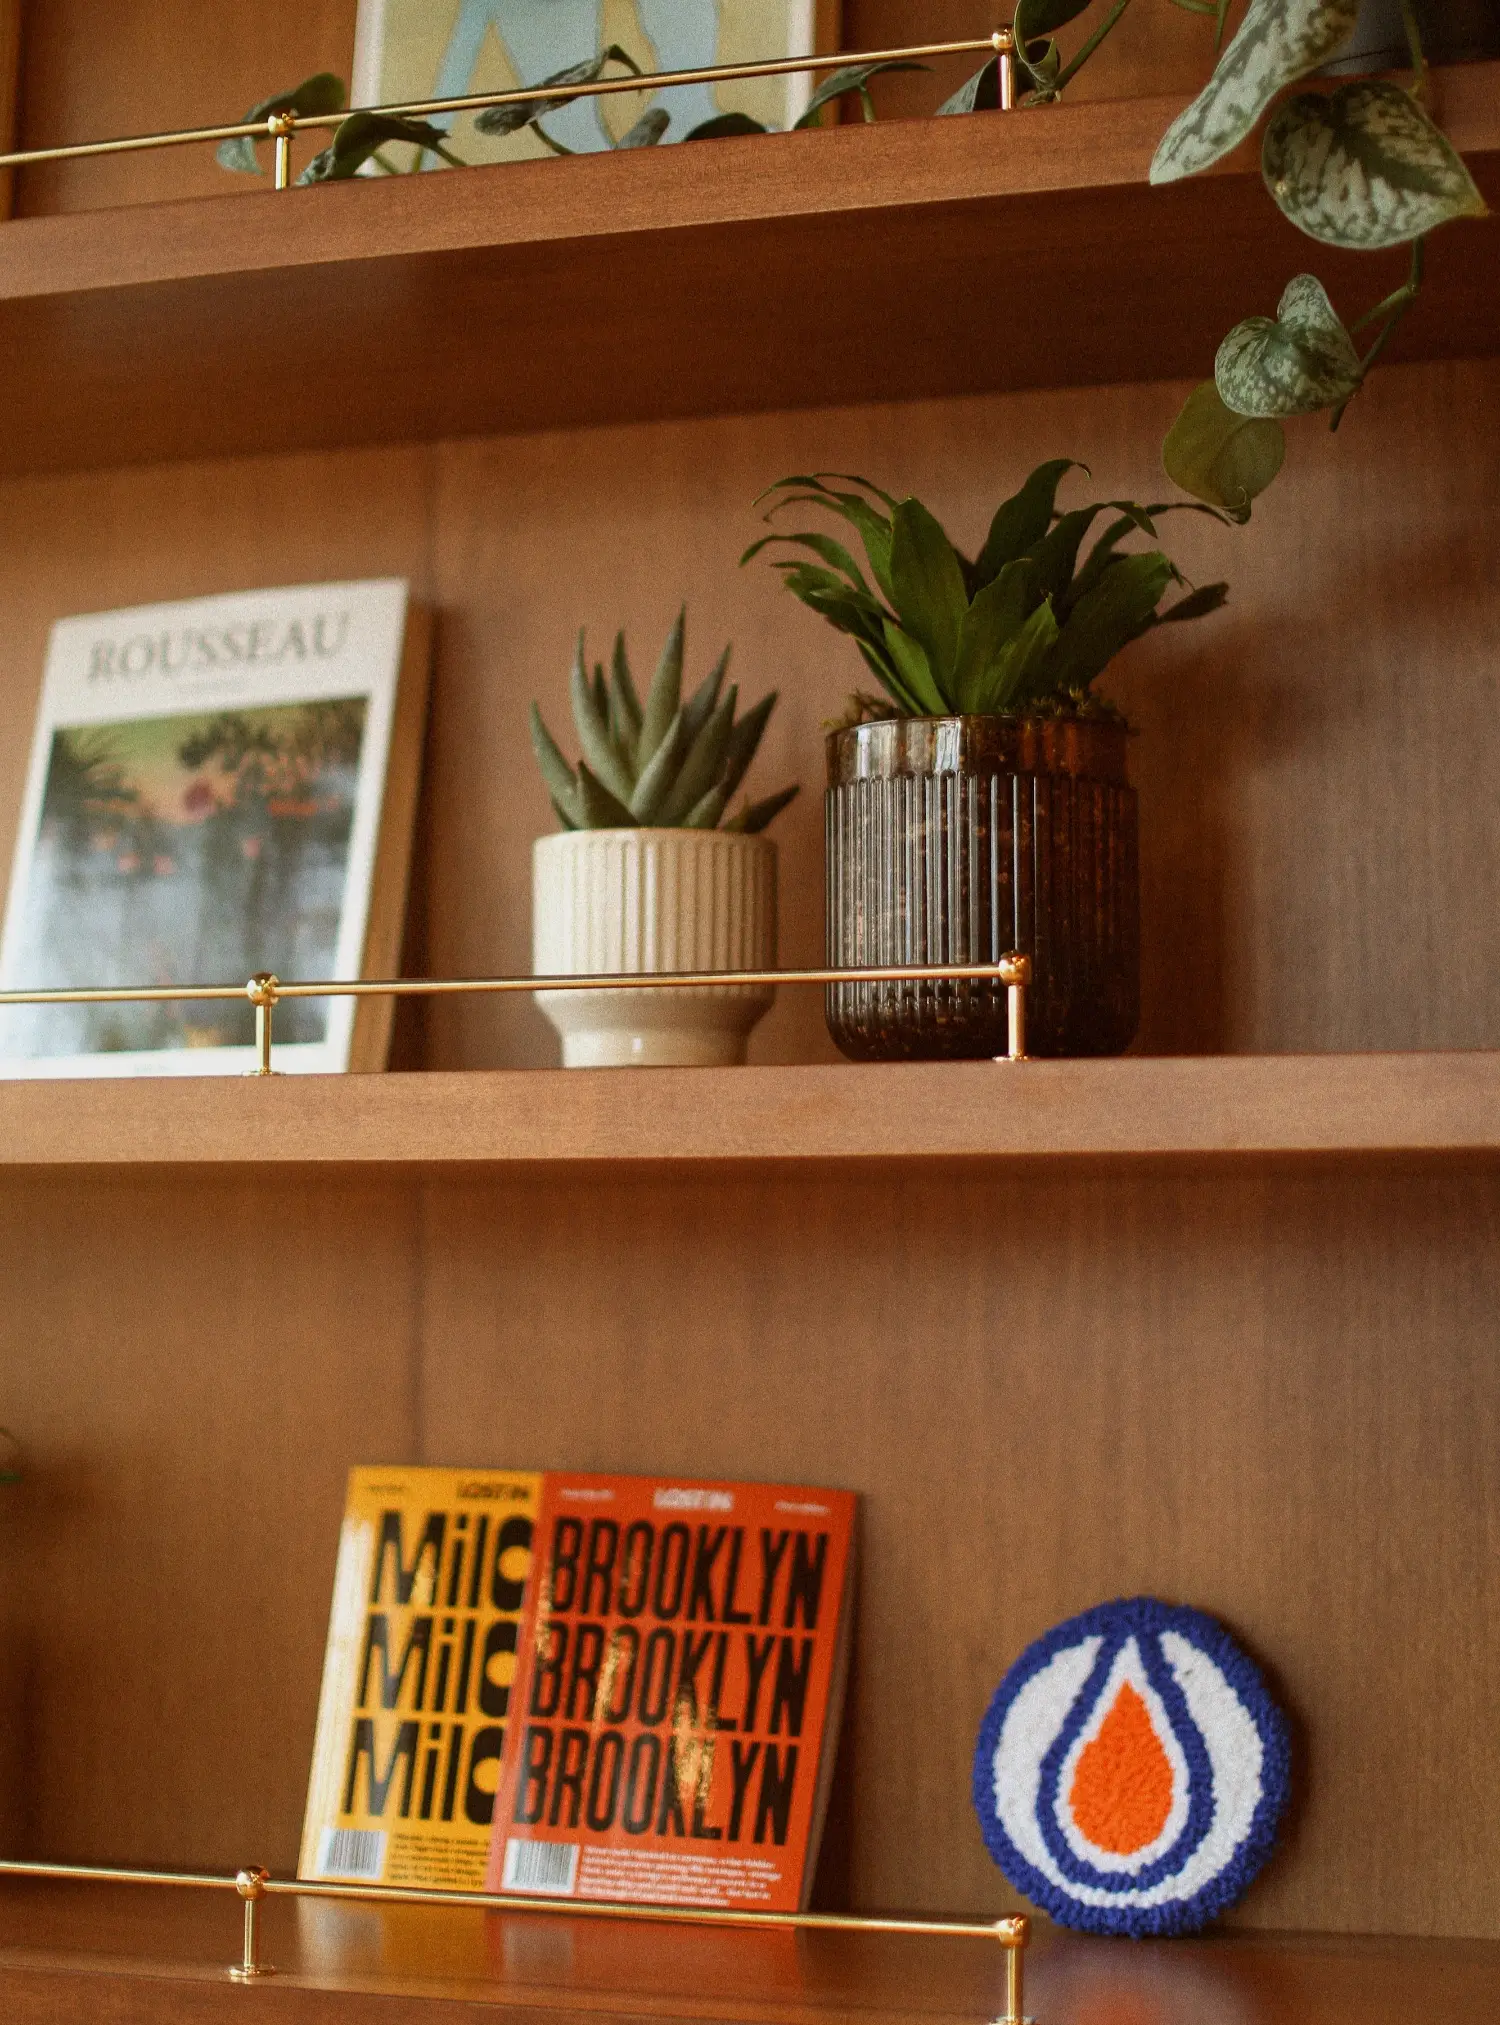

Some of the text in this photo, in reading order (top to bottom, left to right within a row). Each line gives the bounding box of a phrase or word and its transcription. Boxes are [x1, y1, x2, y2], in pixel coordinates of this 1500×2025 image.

[87, 611, 348, 684] ROUSSEAU
[552, 1518, 828, 1628] BROOKLYN
[531, 1623, 813, 1736] BROOKLYN
[514, 1727, 797, 1845] BROOKLYN
